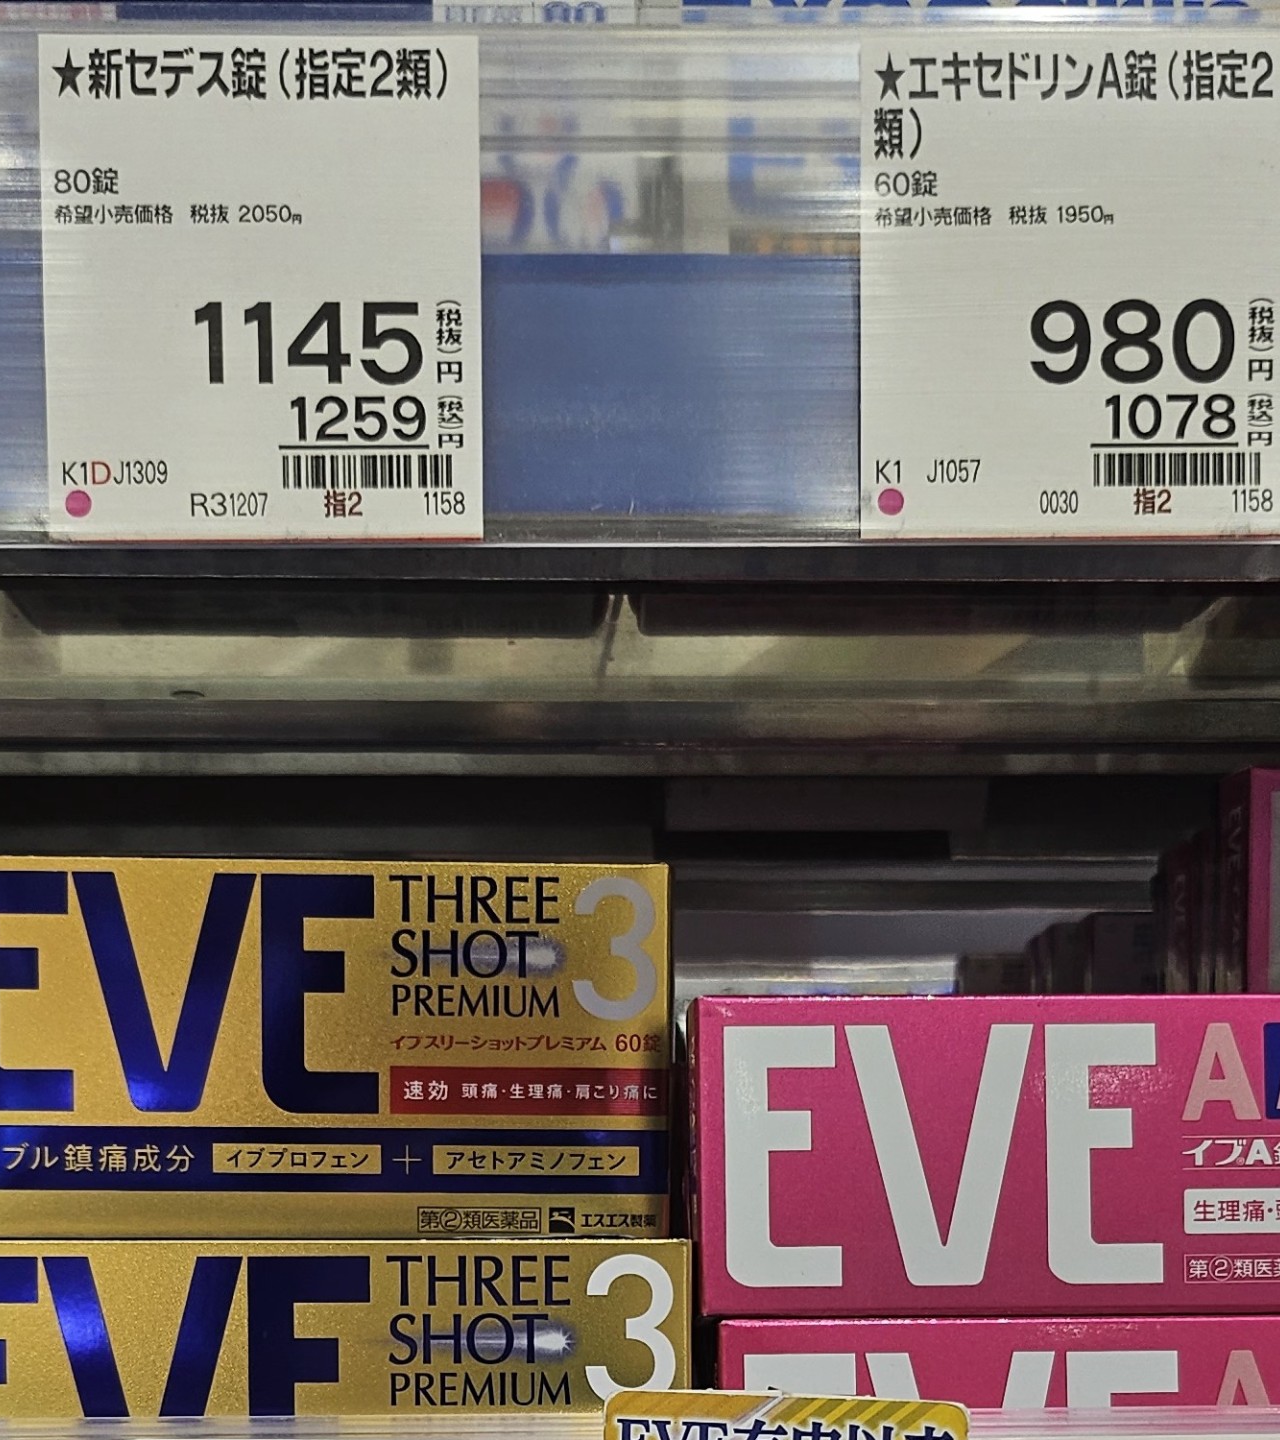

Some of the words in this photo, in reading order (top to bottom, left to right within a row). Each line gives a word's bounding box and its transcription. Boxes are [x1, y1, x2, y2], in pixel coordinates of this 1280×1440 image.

[54, 168, 119, 194] 80錠
[875, 171, 938, 197] 60錠
[54, 204, 173, 225] 希望小売価格
[190, 204, 229, 224] 税抜
[238, 205, 302, 225] 2050円
[875, 206, 992, 227] 希望小売価格
[1056, 206, 1114, 225] 1950円
[193, 301, 424, 385] 1145
[1029, 299, 1235, 384] 980
[289, 396, 427, 442] 1259
[1104, 394, 1237, 440] 1078
[876, 460, 901, 484] K1
[926, 459, 981, 484] J1057
[423, 492, 466, 516] 1158
[1039, 490, 1079, 515] 0030
[389, 875, 561, 924] THREE
[390, 929, 540, 980] SHOT
[391, 984, 561, 1018] PREMIUM
[615, 1033, 661, 1053] 60錠
[225, 1148, 371, 1170] イブプロフェン
[446, 1149, 627, 1170] アセトアミノフェン
[724, 1022, 1164, 1287] EVE
